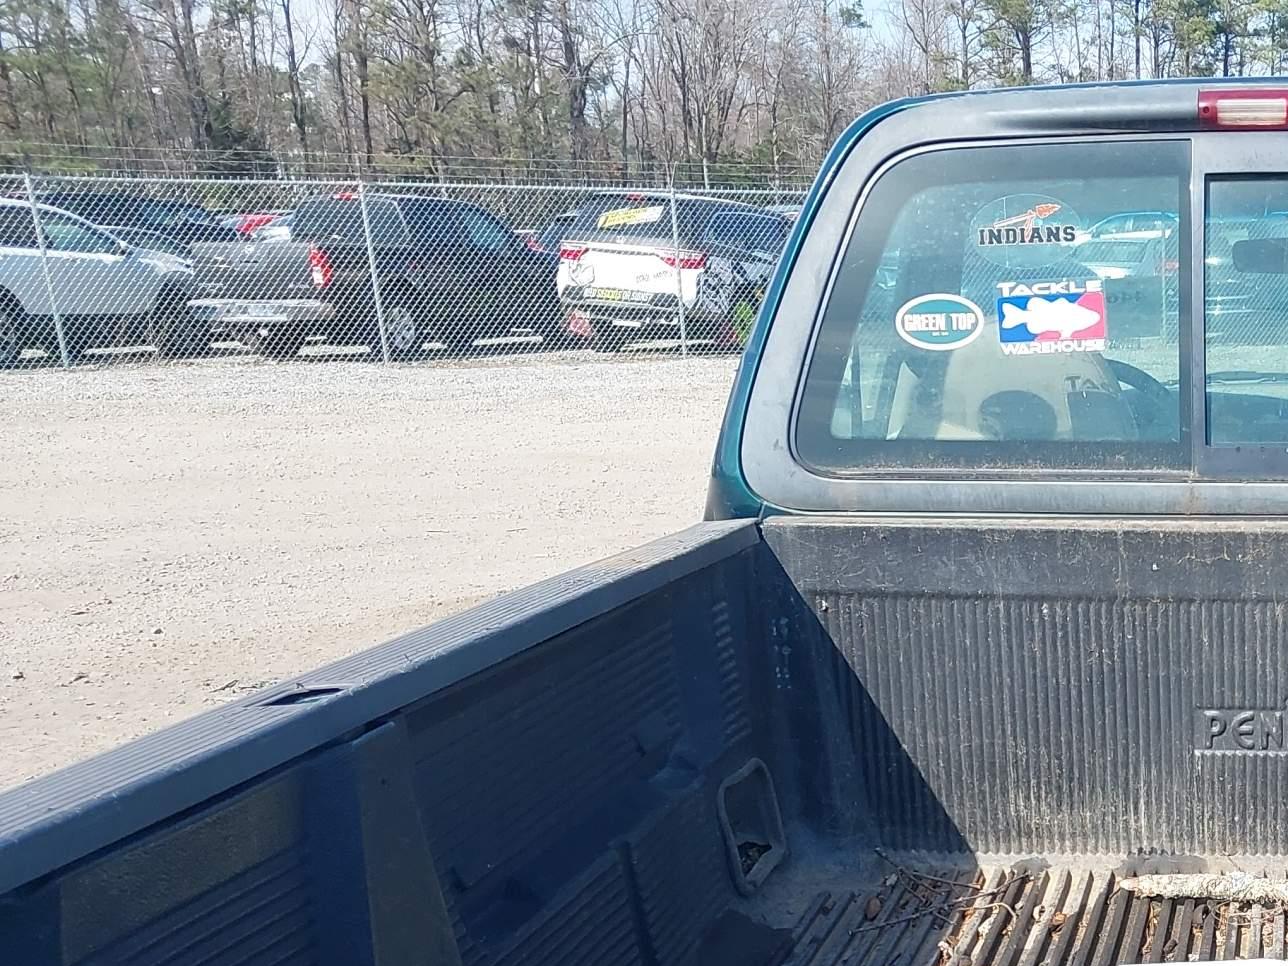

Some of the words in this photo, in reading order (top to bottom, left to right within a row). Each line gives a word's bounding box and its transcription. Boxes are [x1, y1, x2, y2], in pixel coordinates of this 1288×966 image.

[977, 225, 1077, 246] INDIANS
[997, 280, 1104, 296] TACKLE
[904, 313, 946, 331] GREEN
[950, 312, 977, 331] TOP
[1000, 339, 1106, 356] WAREHOUSE
